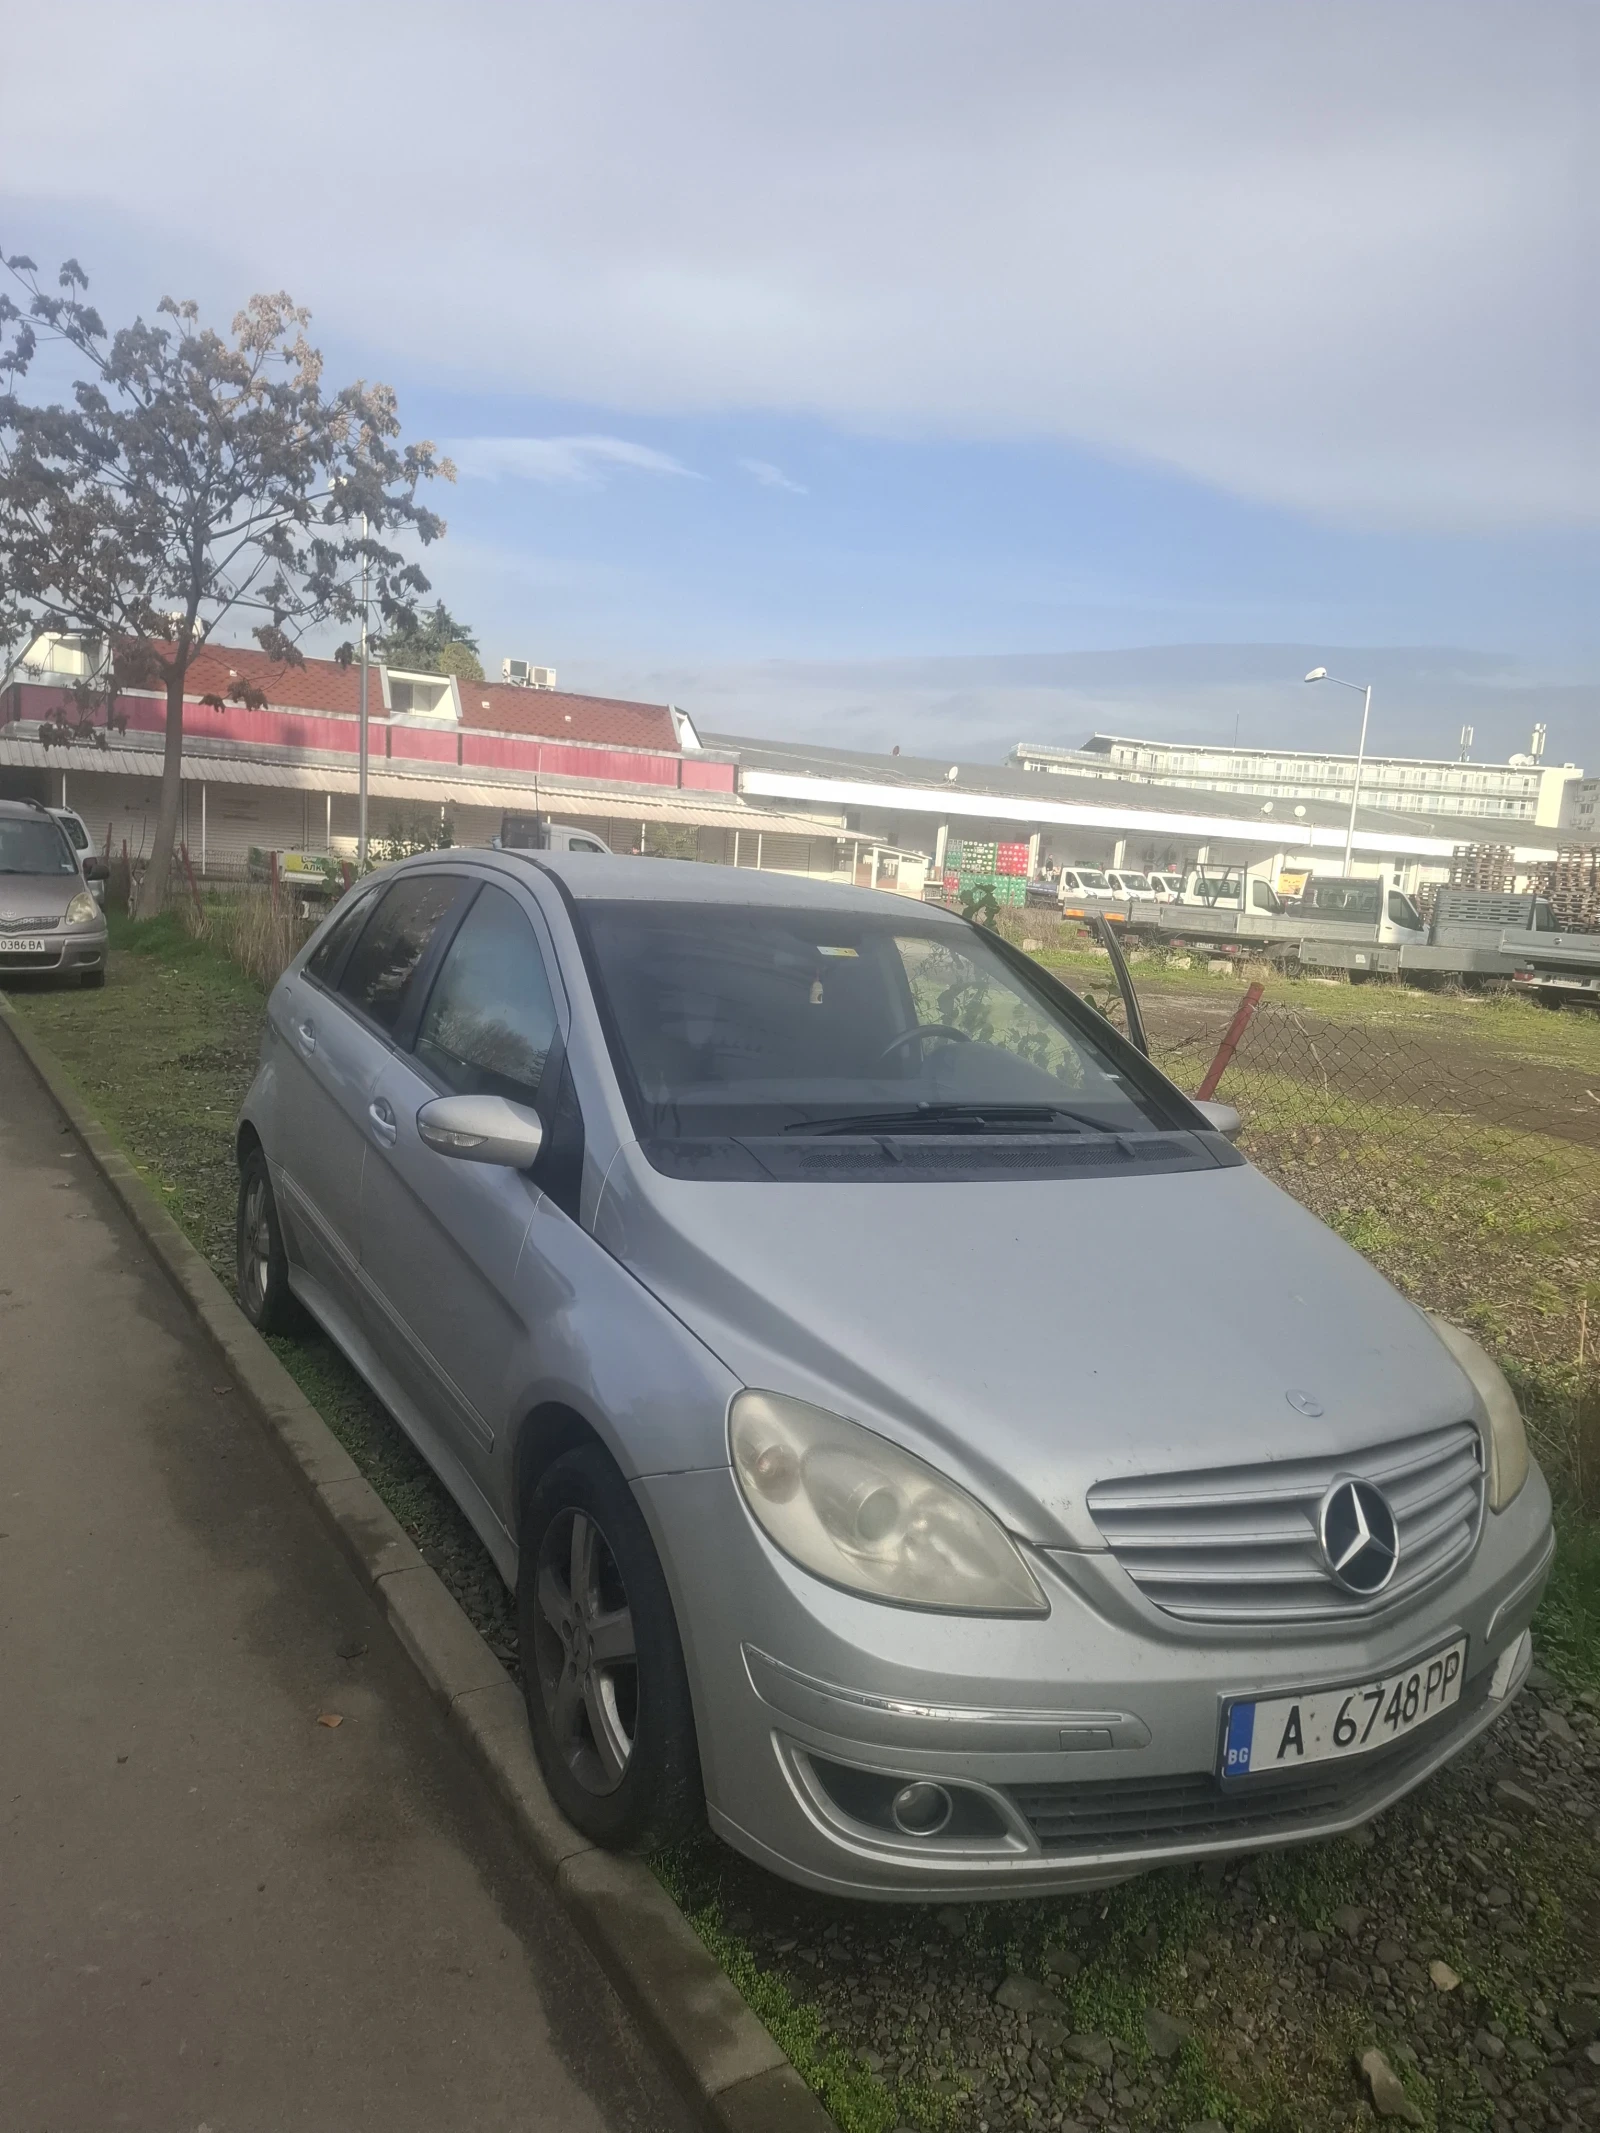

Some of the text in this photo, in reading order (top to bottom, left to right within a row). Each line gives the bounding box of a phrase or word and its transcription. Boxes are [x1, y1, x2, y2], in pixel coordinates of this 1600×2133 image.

[1, 940, 26, 950] 0386
[1277, 1705, 1304, 1759] A
[1228, 1747, 1249, 1765] BG
